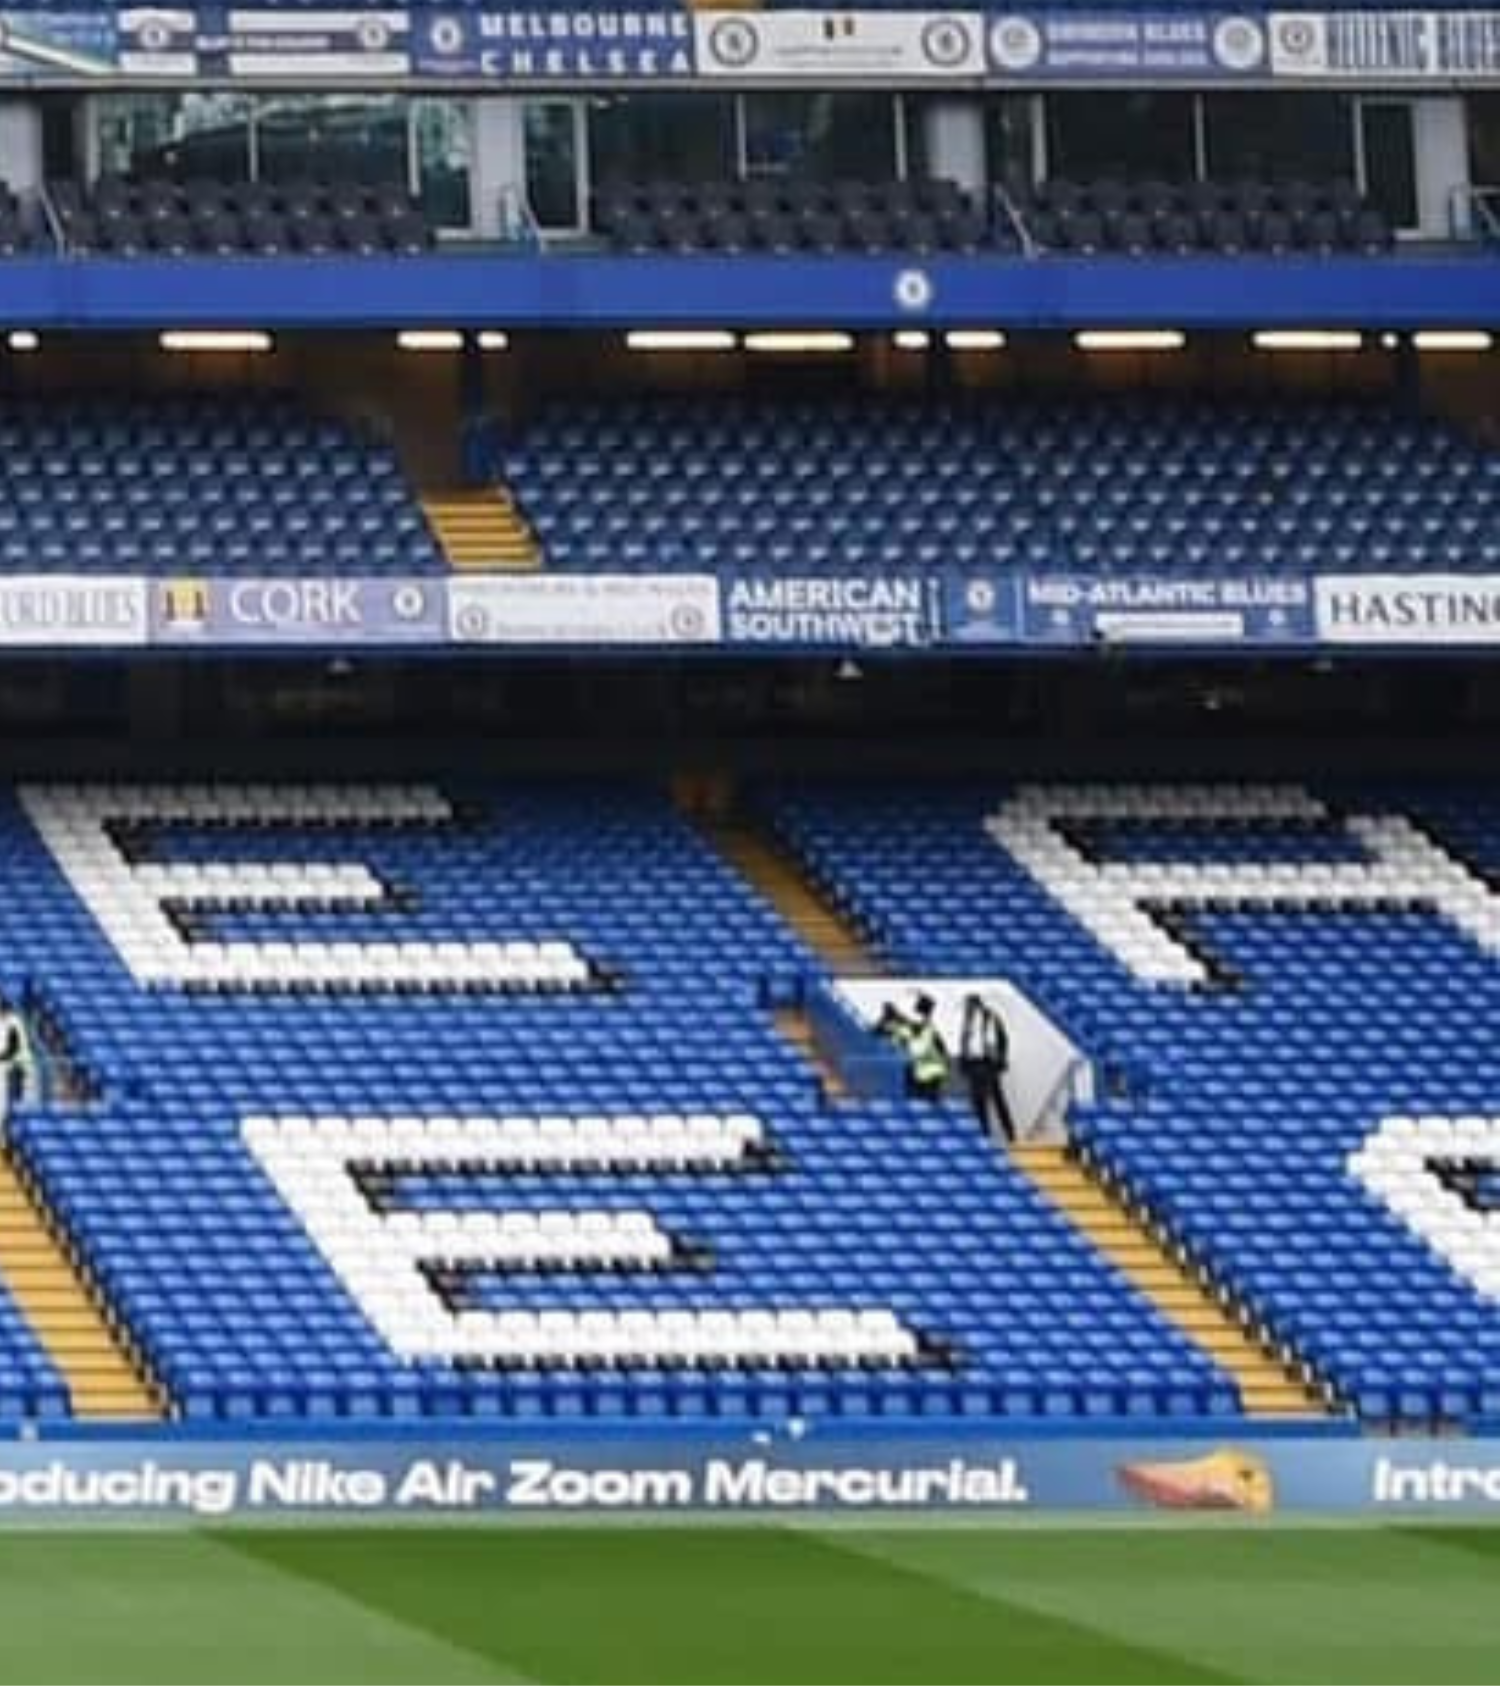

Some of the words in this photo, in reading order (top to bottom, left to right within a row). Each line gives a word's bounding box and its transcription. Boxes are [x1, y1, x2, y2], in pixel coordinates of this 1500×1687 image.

[479, 13, 688, 37] MELBOURNE
[479, 49, 688, 74] CHELSEA
[230, 579, 362, 624] CORK
[730, 577, 921, 610] AMERICAN
[1028, 578, 1218, 606] MID-ATLANTIC
[1221, 578, 1309, 606] BLUES
[1330, 591, 1500, 625] HASTIN
[249, 1460, 386, 1505] Nike
[395, 1460, 495, 1505] Air
[507, 1459, 692, 1505] Zoom
[704, 1458, 1029, 1503] Mercurial.
